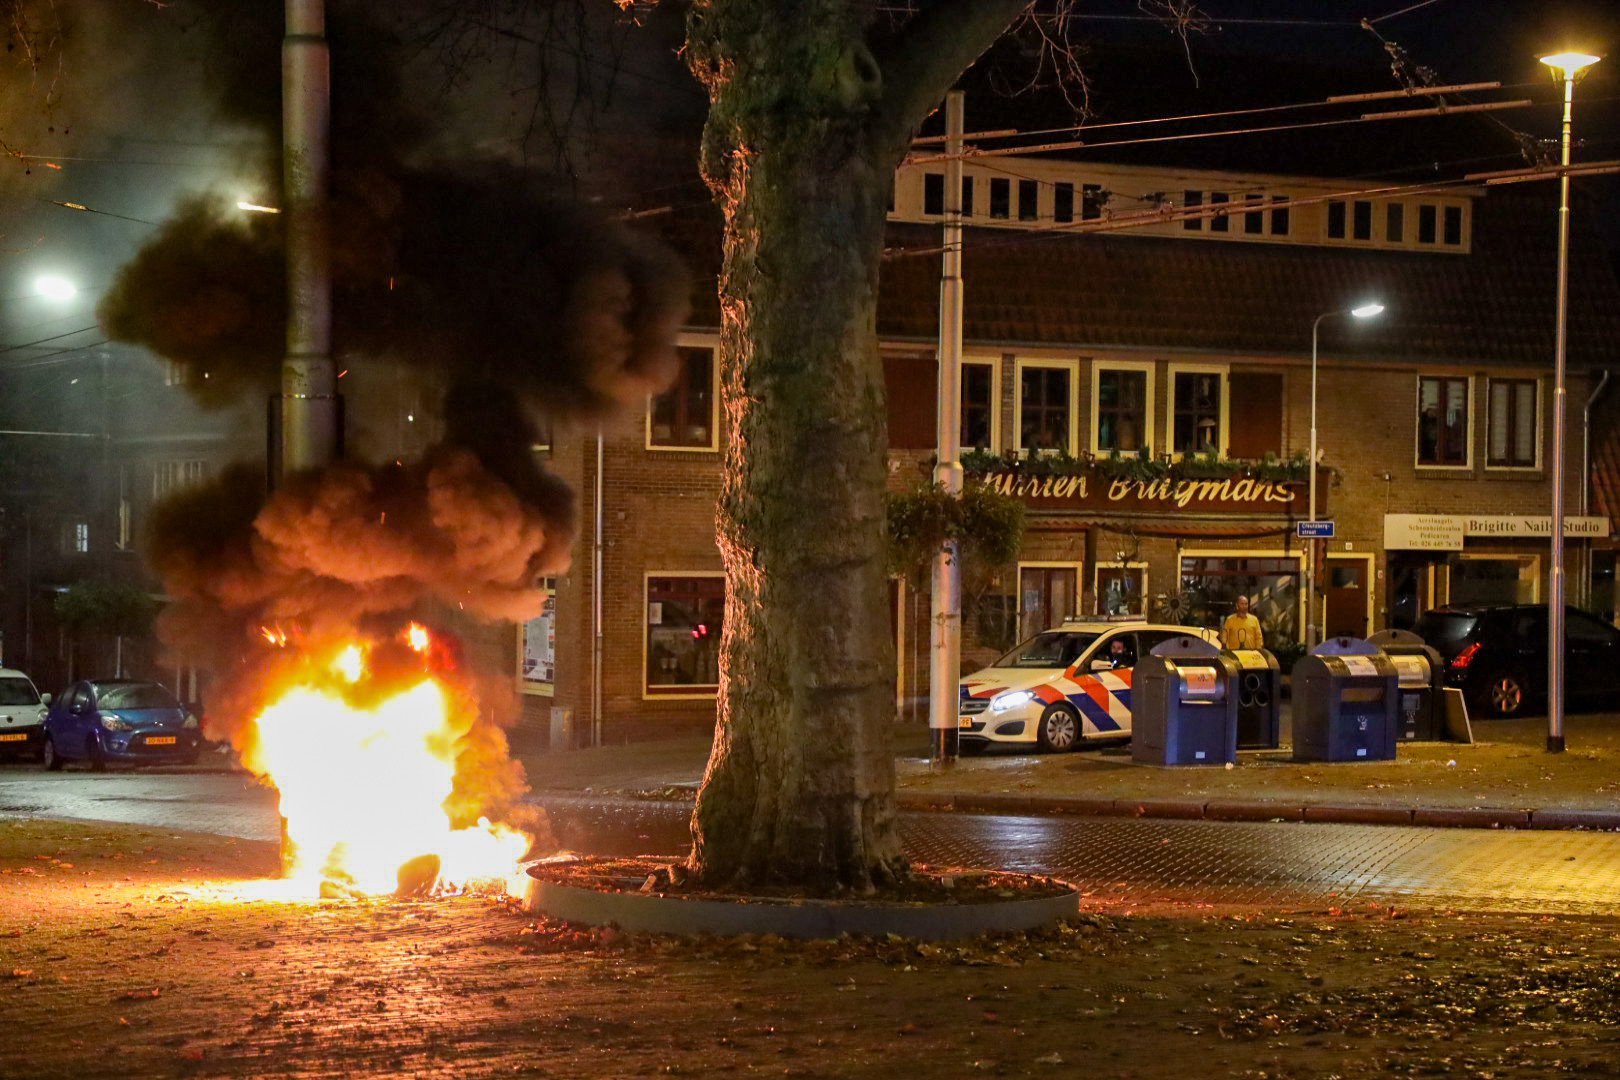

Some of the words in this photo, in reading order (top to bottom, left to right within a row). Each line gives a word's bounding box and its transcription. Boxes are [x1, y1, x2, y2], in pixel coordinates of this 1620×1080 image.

[1469, 520, 1516, 533] Brigitte
[1524, 520, 1552, 532] Nail
[1563, 521, 1600, 532] Studio
